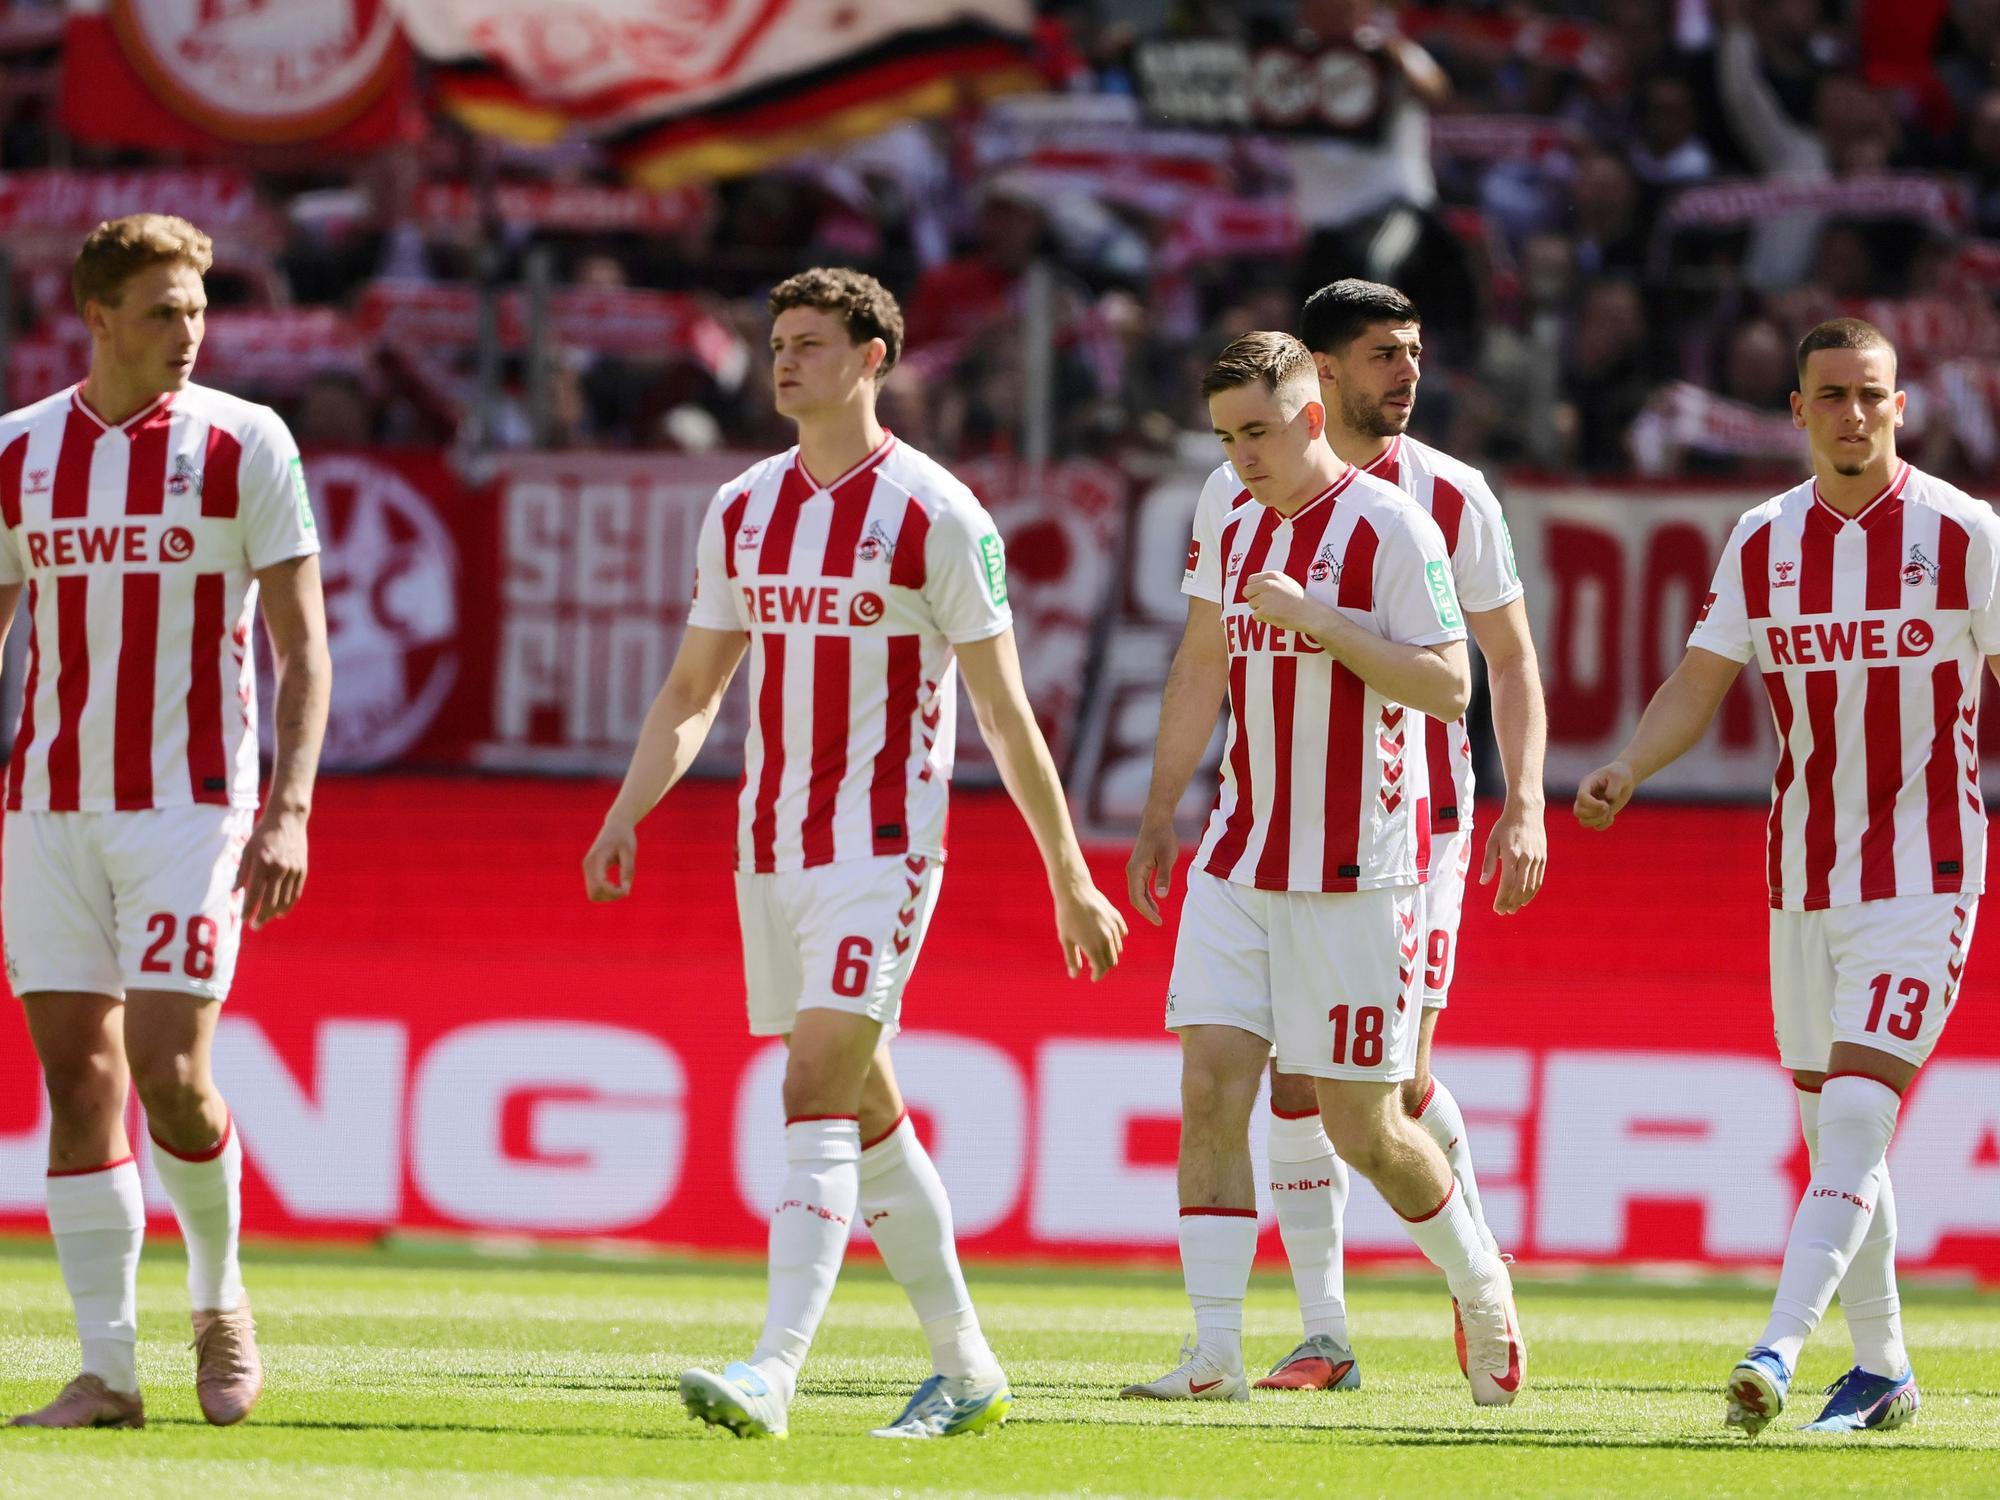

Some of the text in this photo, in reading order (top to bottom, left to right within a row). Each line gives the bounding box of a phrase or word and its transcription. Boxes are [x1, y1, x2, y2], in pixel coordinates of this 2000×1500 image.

[28, 526, 148, 568] REWE
[742, 585, 839, 625] REWE
[1431, 568, 1457, 623] DEVK
[1226, 614, 1287, 654] EWE
[1766, 619, 1888, 665] REWE
[140, 911, 217, 980] 28
[832, 935, 872, 998] 6
[1864, 973, 1930, 1041] 13
[1328, 1004, 1384, 1067] 18
[0, 1015, 690, 1231] NG
[1287, 1178, 1330, 1191] KÖLN
